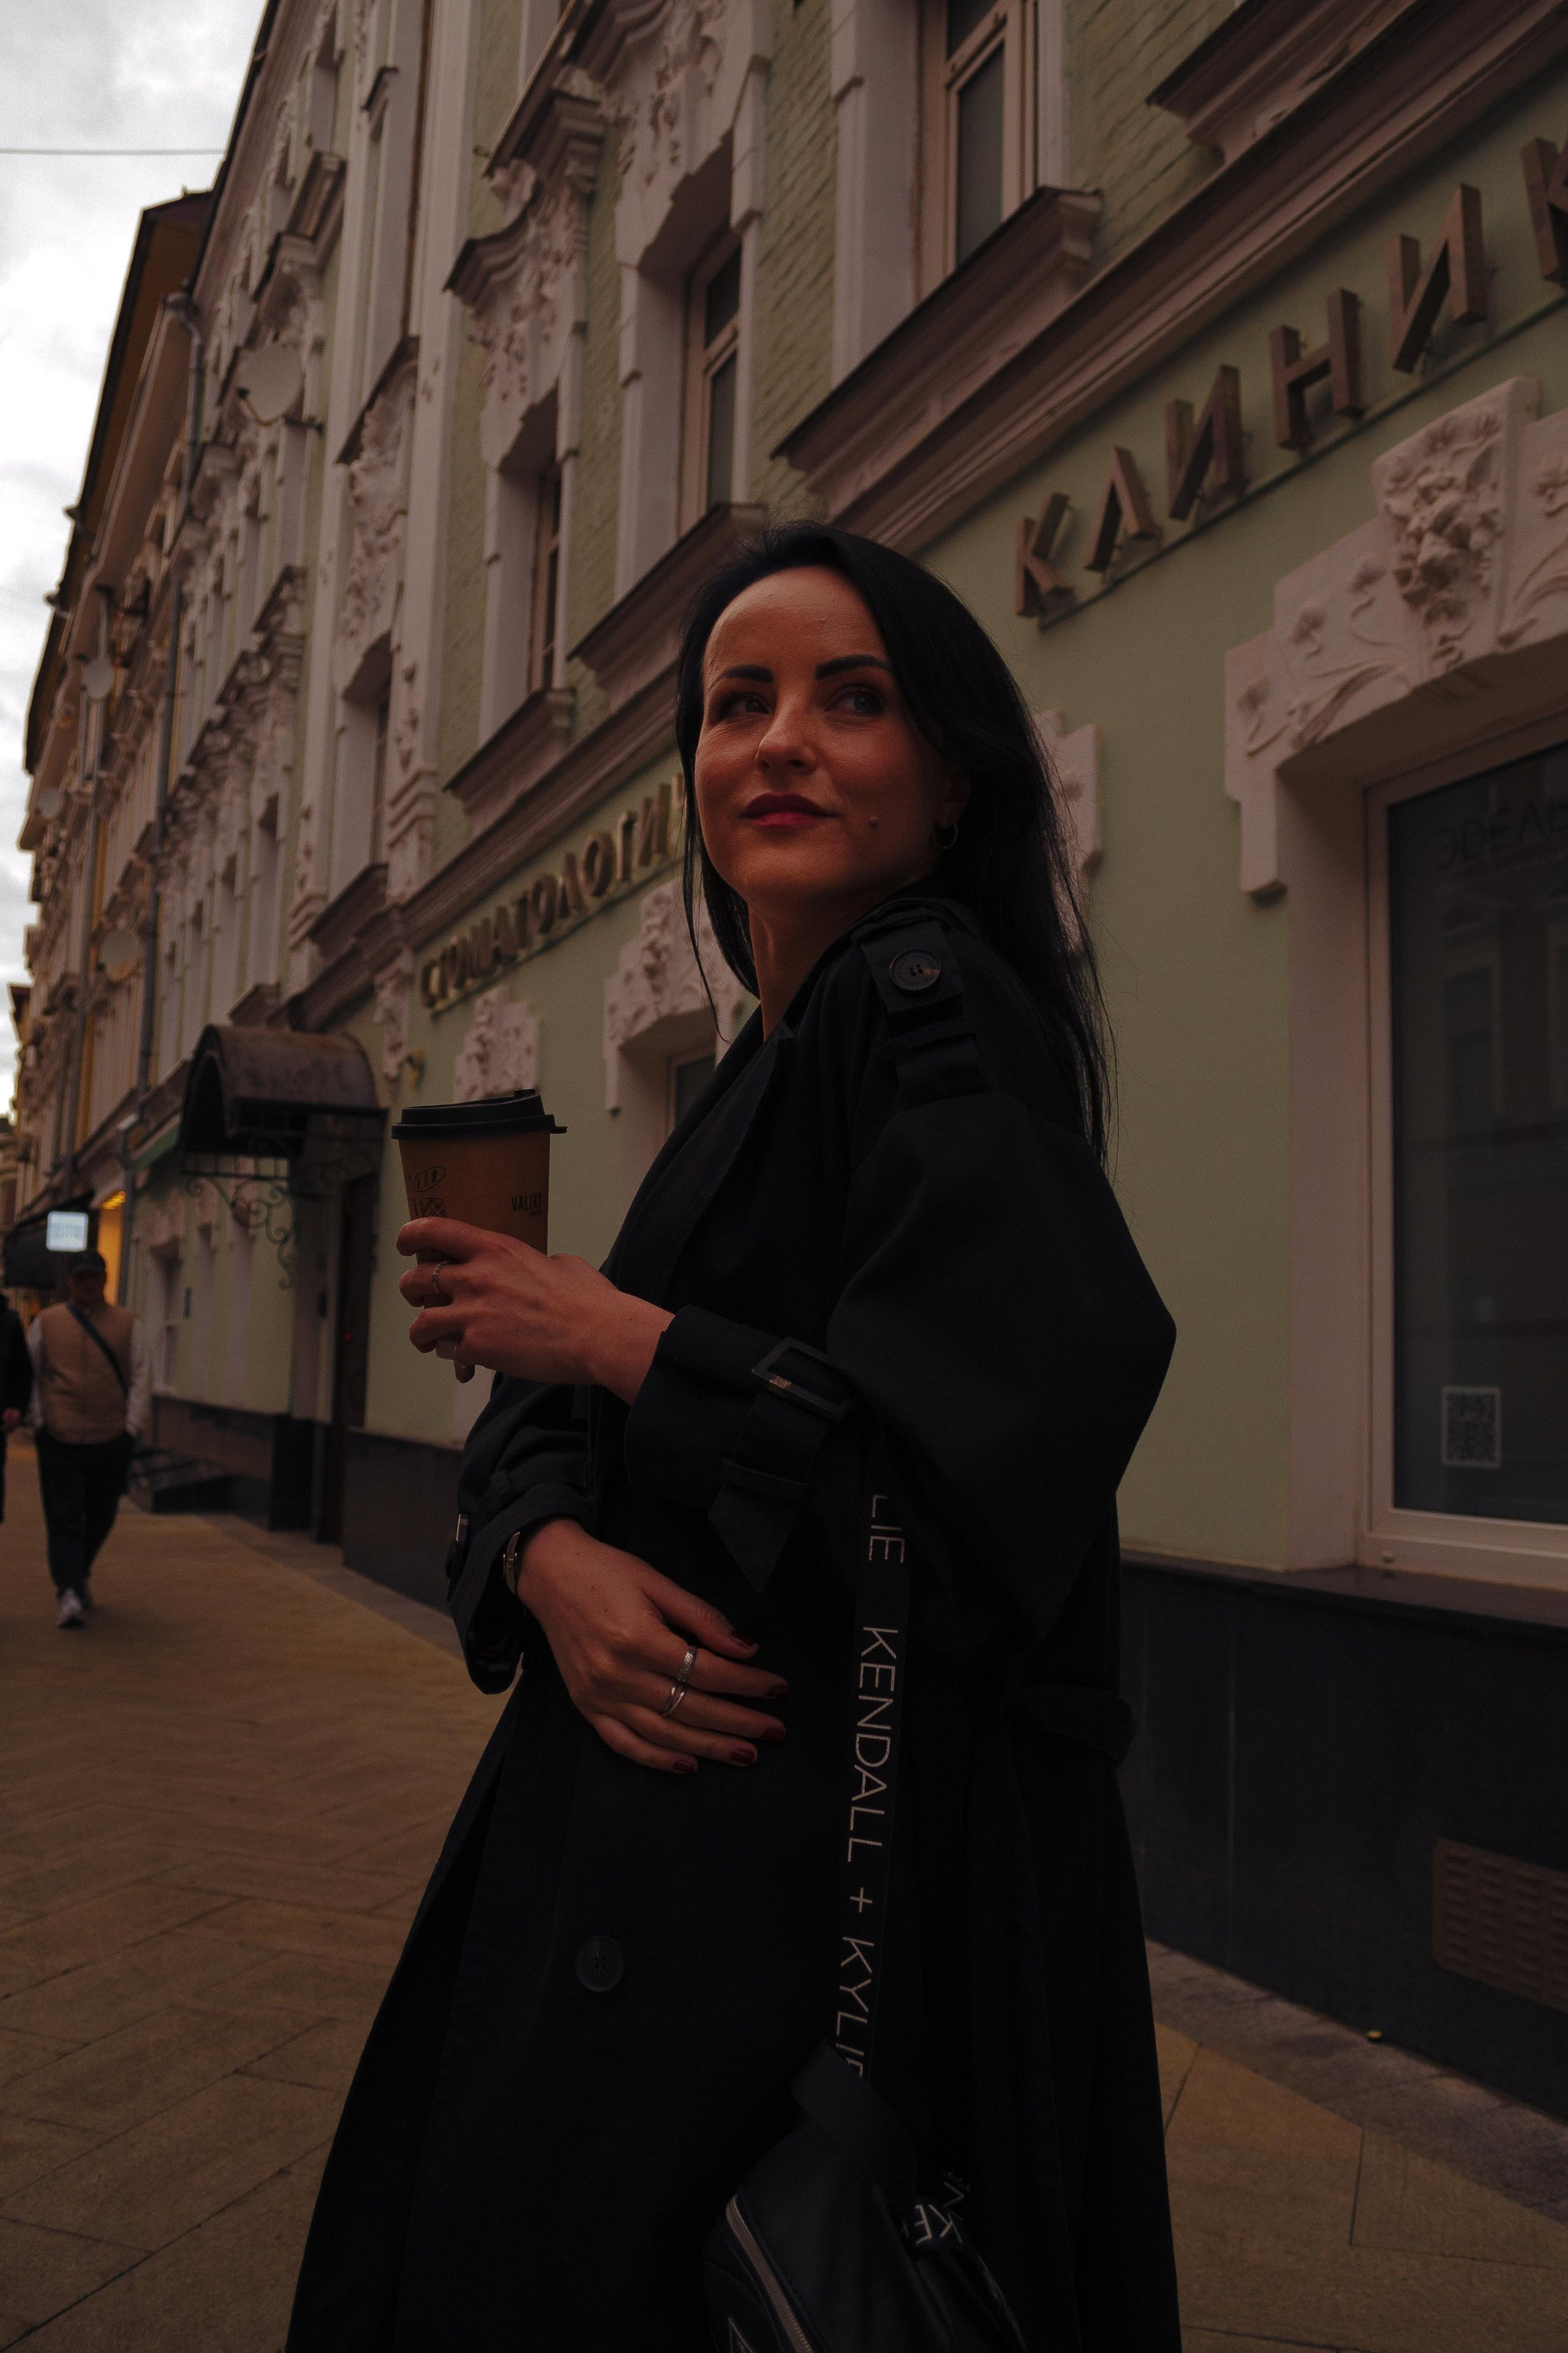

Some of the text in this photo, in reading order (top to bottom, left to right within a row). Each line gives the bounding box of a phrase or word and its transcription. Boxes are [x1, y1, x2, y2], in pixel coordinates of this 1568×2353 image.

[420, 773, 685, 1008] СТОМАТОЛОГИ
[869, 1495, 906, 1563] LIE
[847, 1626, 899, 1862] KENDALL
